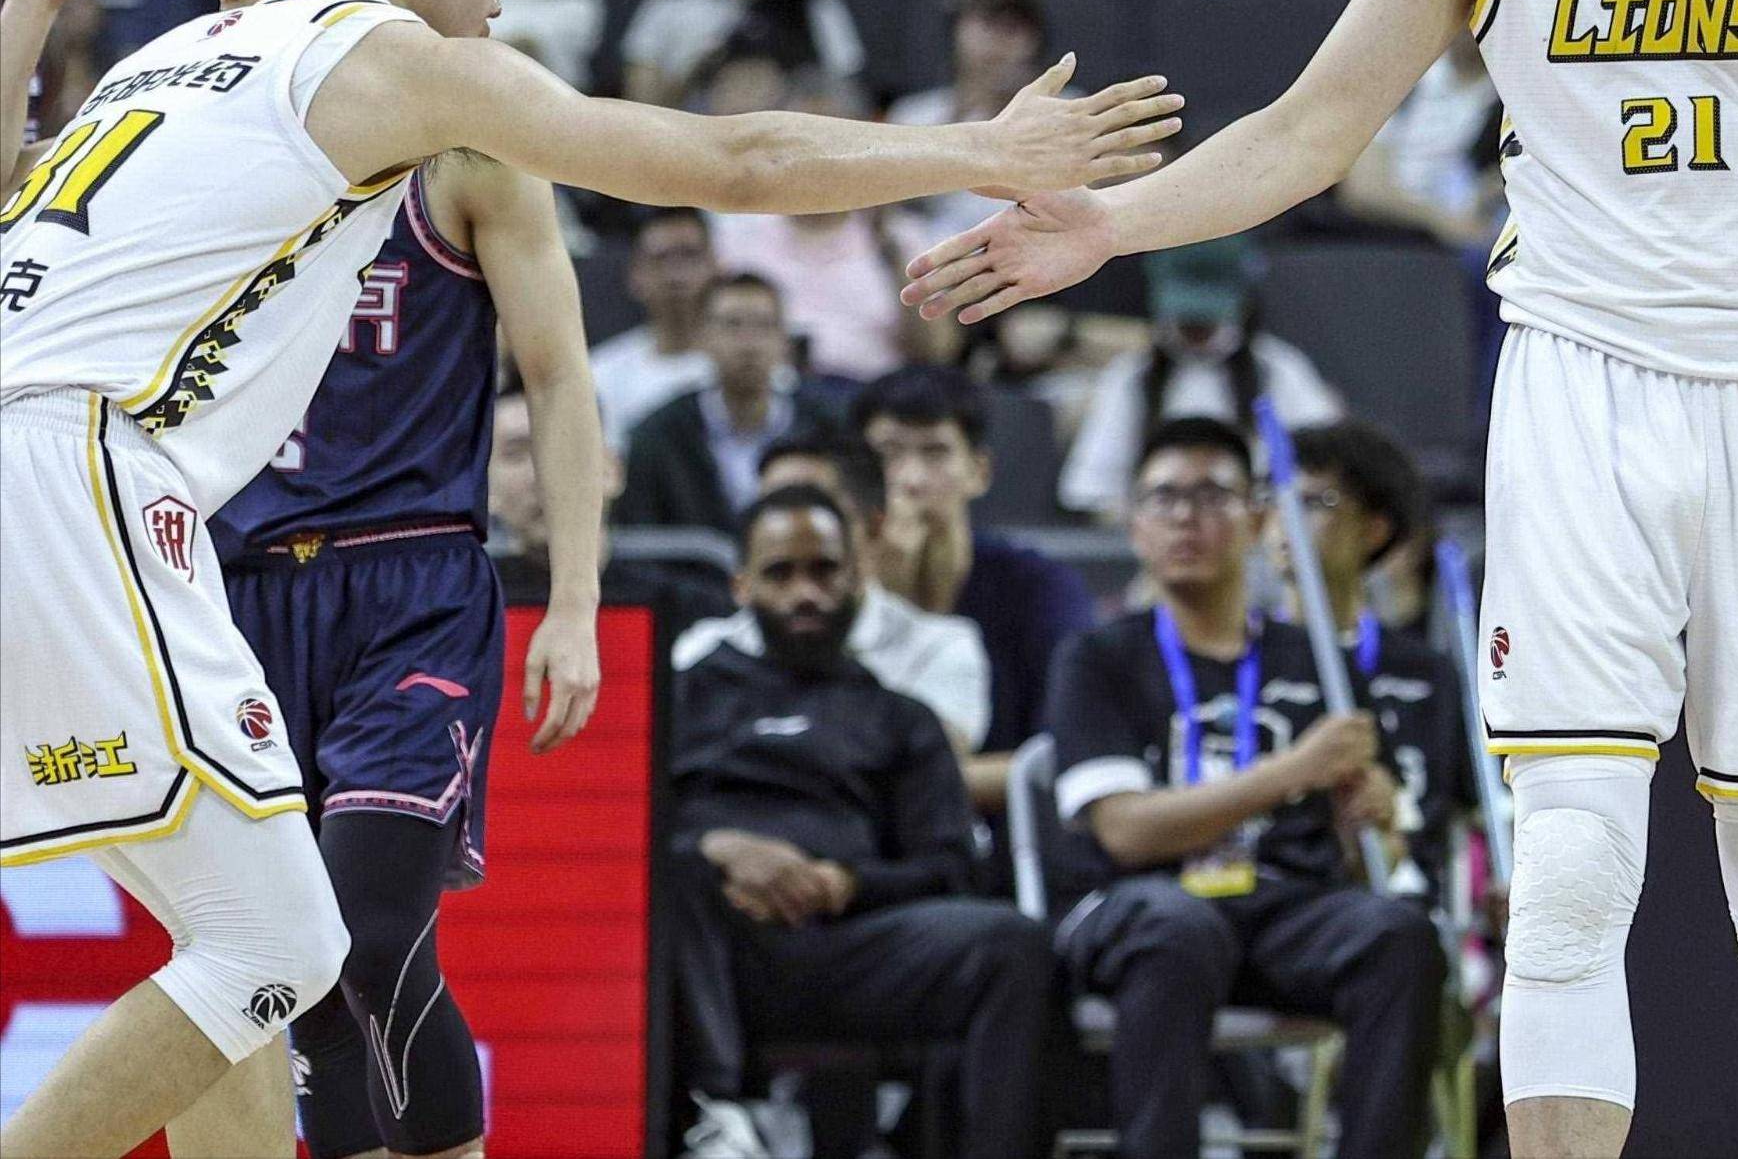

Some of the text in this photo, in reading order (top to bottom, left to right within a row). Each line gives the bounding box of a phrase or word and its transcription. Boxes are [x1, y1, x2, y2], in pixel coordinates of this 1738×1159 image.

[81, 53, 262, 116] 东阳光药
[1621, 95, 1731, 175] 21
[24, 730, 137, 786] 浙江
[250, 739, 278, 752] CBA
